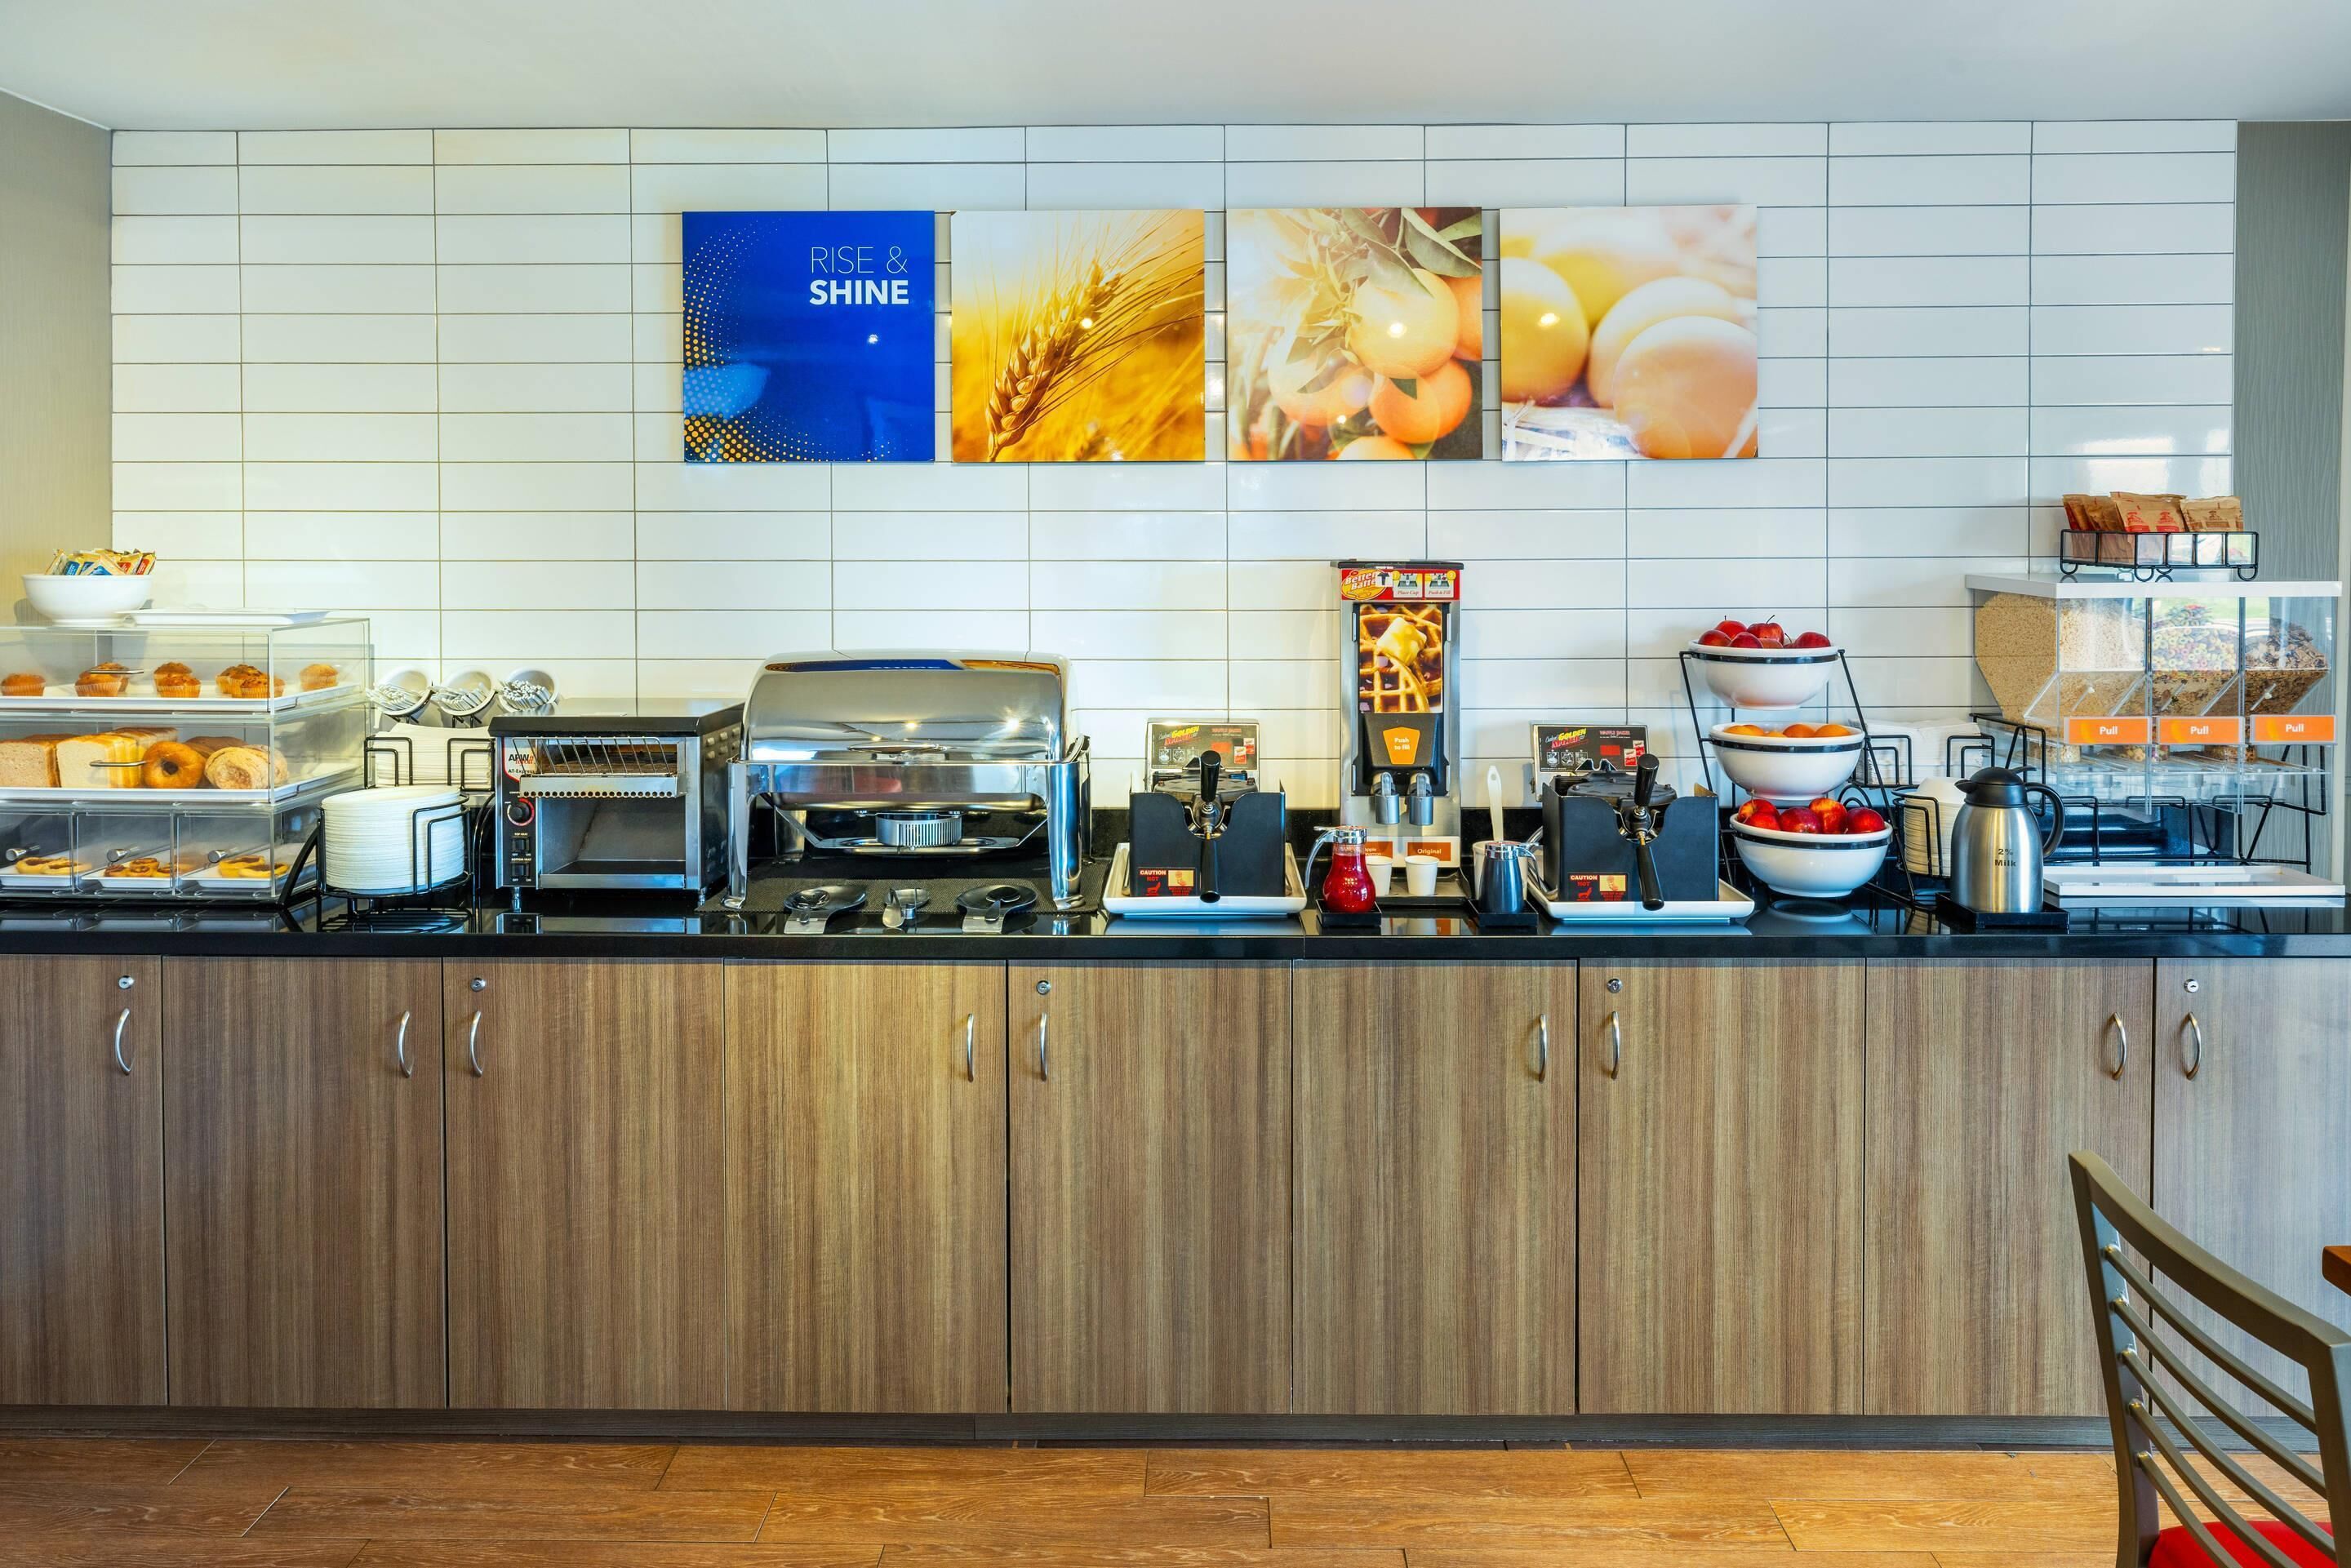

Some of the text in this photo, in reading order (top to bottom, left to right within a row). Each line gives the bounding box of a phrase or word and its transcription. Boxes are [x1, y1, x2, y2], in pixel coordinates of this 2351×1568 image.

[811, 246, 908, 274] RISE &
[809, 279, 909, 305] SHINE
[1350, 578, 1376, 591] Batte
[2100, 726, 2118, 735] Pull
[2190, 726, 2209, 735] Pull
[2285, 723, 2304, 733] Pull
[1998, 848, 2014, 856] 2%
